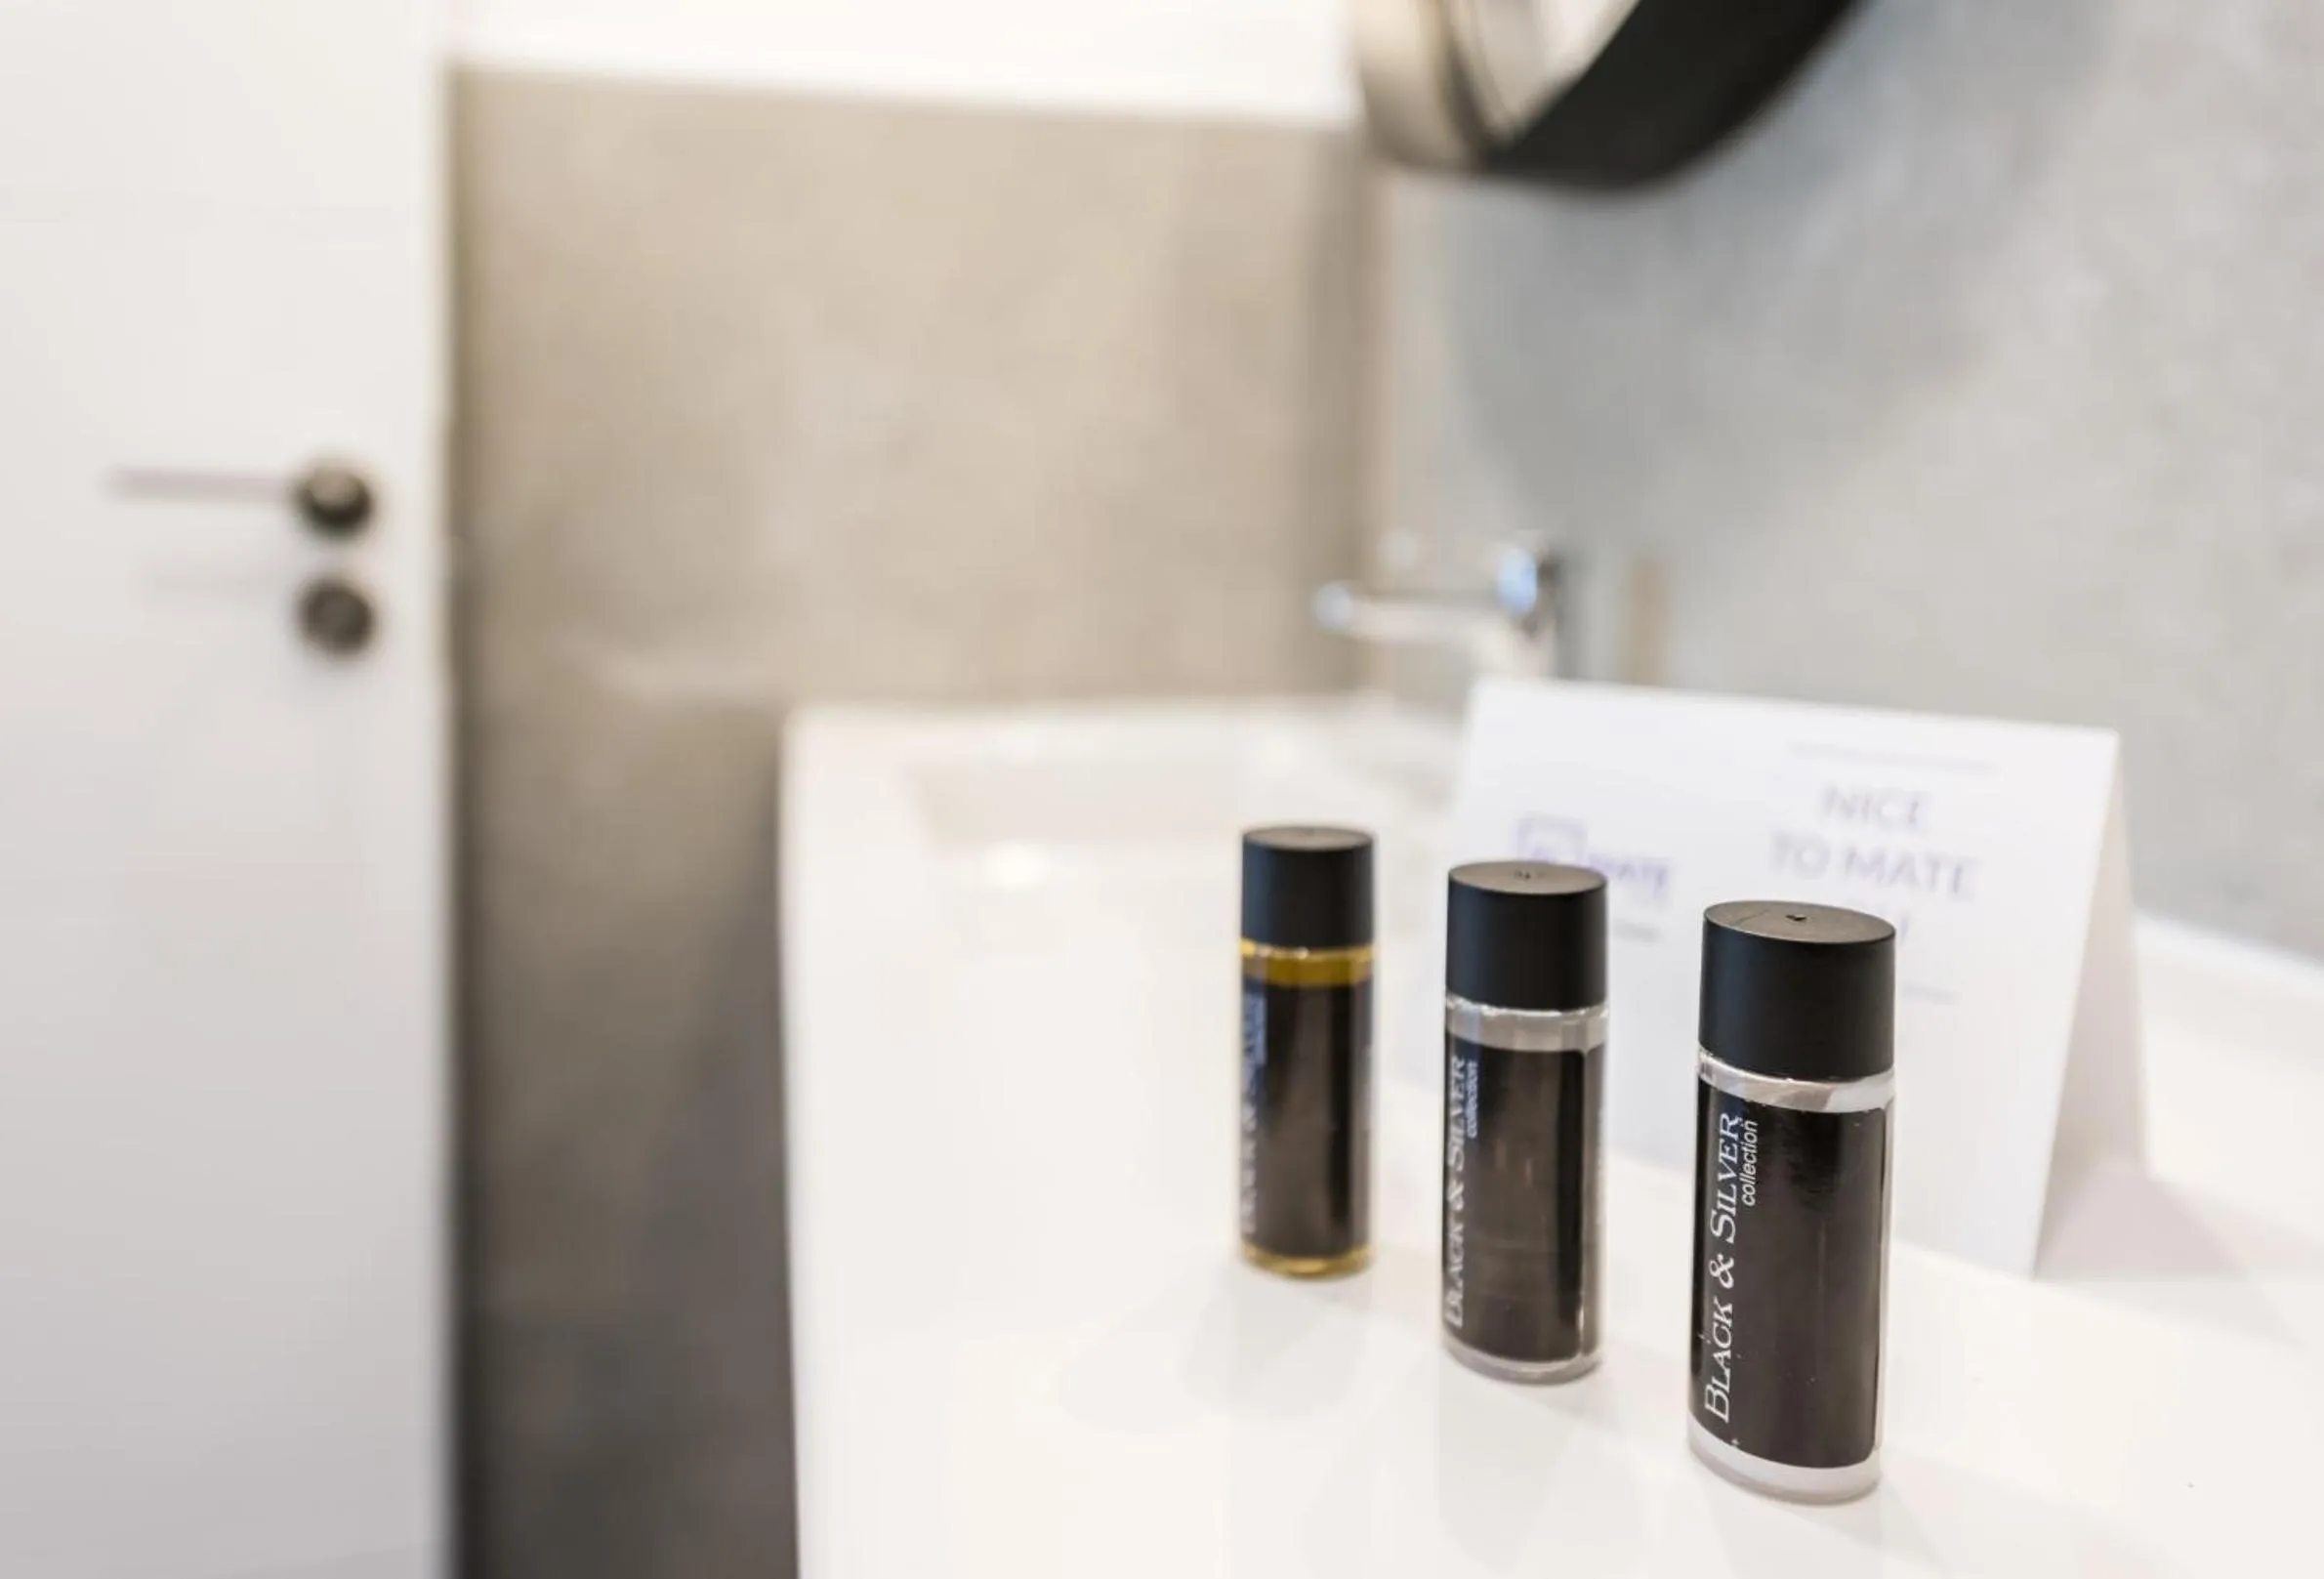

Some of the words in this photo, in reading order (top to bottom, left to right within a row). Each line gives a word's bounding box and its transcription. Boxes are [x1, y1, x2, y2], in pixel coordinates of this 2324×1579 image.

[1710, 1112, 1741, 1244] SILVER
[1739, 1120, 1759, 1207] collection
[1709, 1253, 1734, 1289] &
[1704, 1300, 1733, 1423] BLACK
